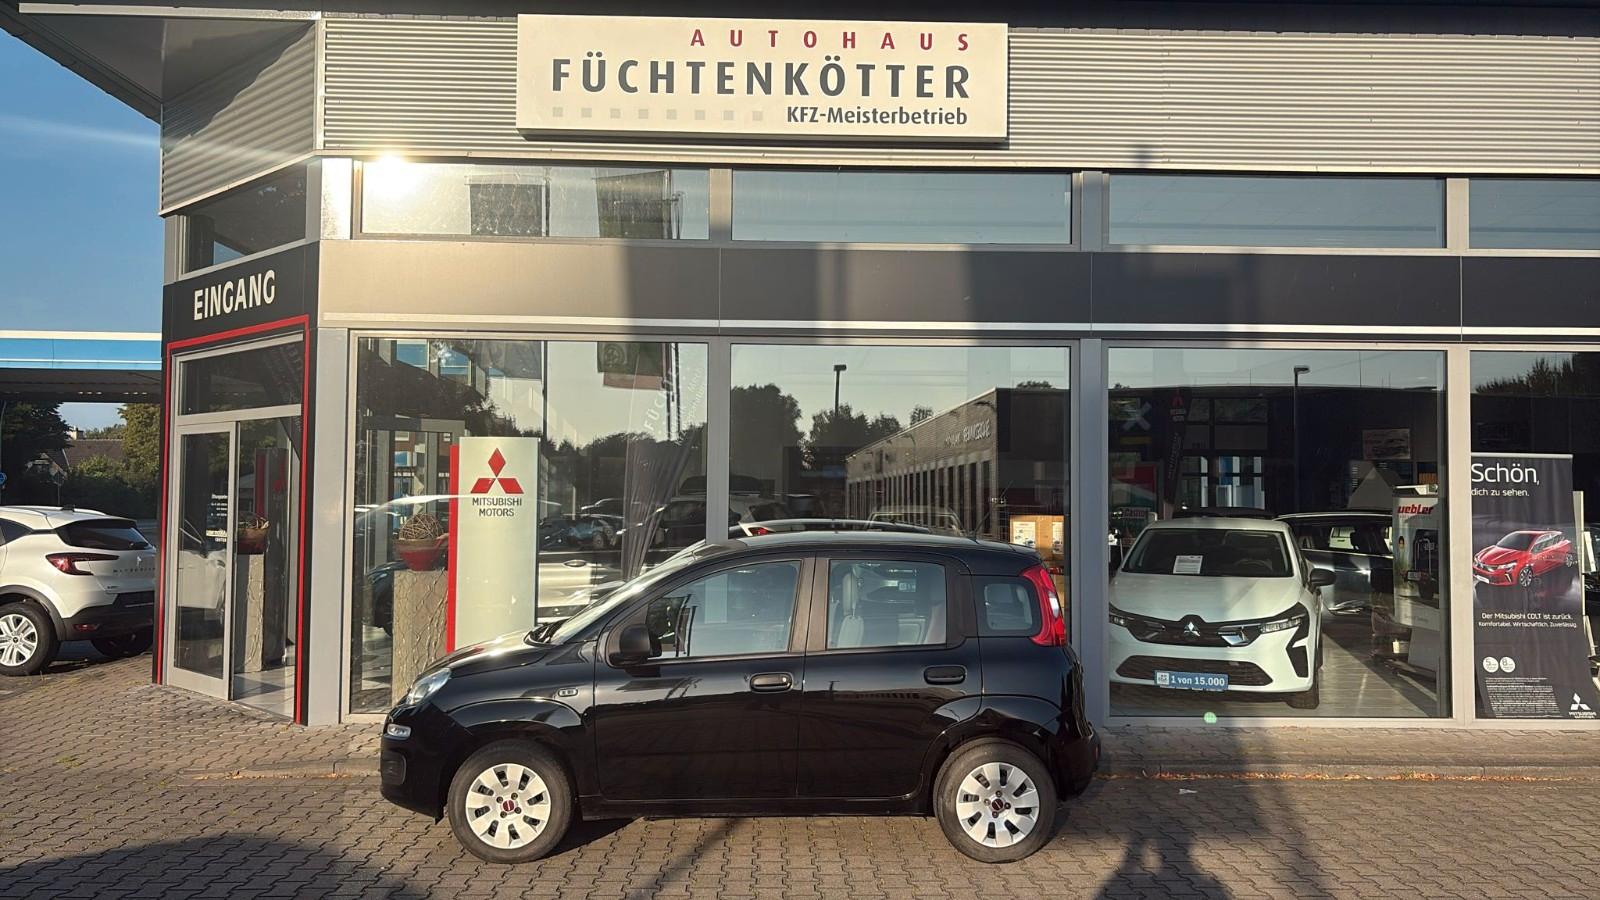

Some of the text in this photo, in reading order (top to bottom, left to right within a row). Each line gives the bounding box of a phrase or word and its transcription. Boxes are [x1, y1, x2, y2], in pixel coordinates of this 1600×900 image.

[690, 27, 969, 51] AUTOHAUS
[552, 51, 970, 99] FÜCHTENKÖTTER
[787, 106, 968, 125] KFZ-Meisterbetrieb
[194, 269, 276, 321] EINGANG
[1471, 462, 1540, 486] Schön,
[1471, 488, 1489, 496] dich
[1502, 488, 1530, 497] sehen.
[472, 497, 523, 506] MITSUBISHI
[479, 508, 515, 517] MOTORS
[1494, 612, 1526, 620] Mitsubishi
[1527, 612, 1541, 620] COLT
[1171, 675, 1225, 687] 1 von 15.000
